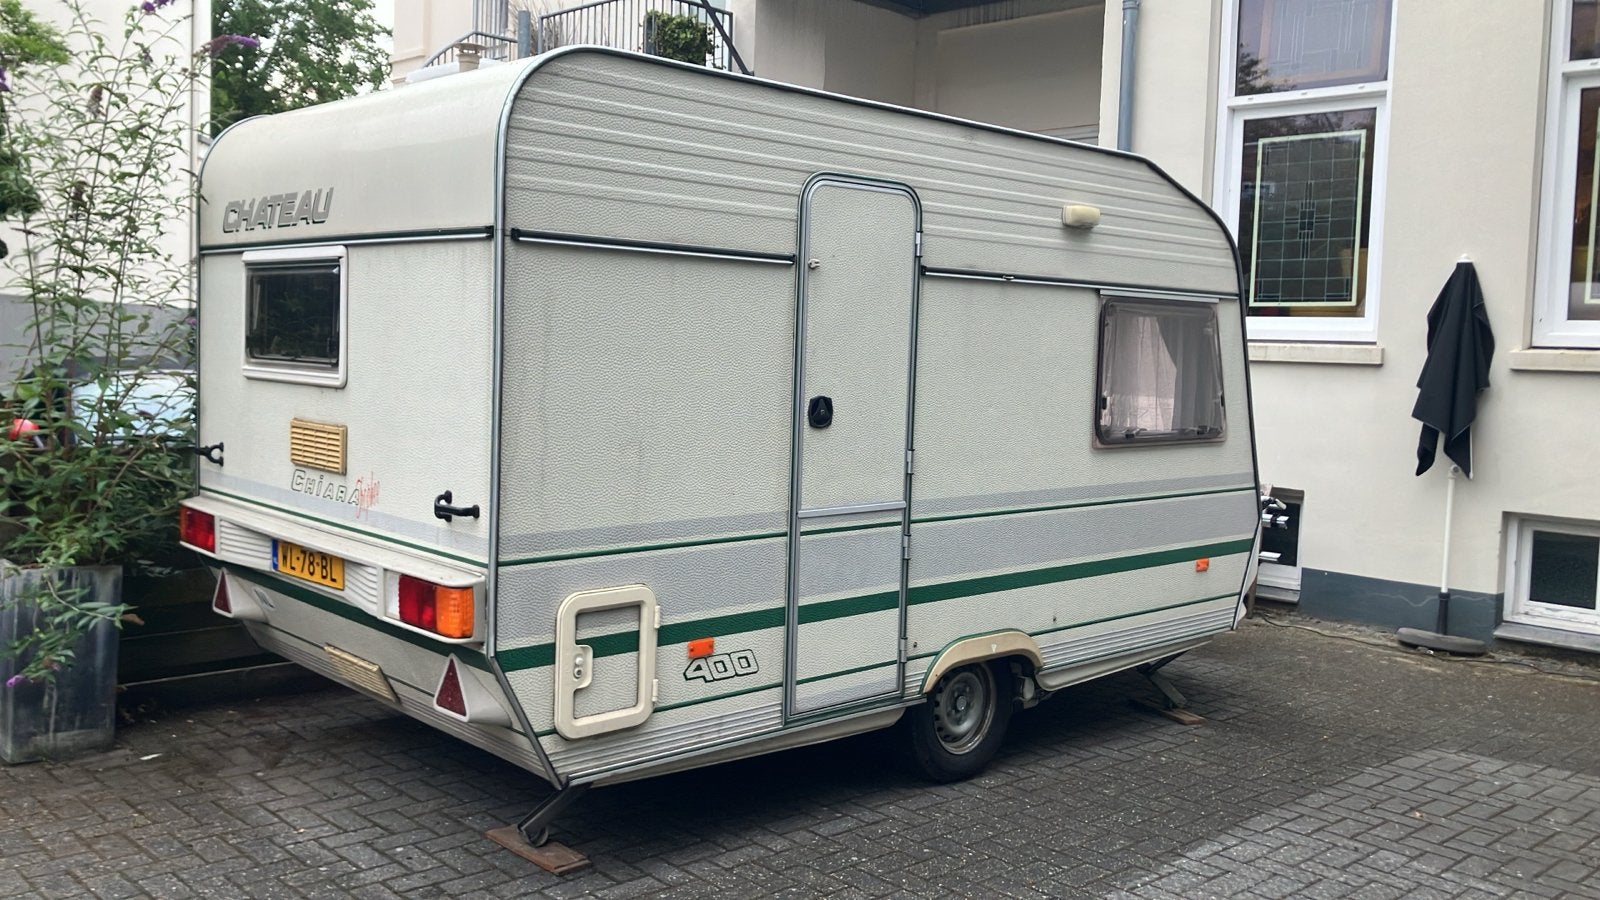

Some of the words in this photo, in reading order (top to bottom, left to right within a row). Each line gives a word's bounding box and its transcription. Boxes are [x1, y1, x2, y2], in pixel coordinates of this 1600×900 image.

[223, 187, 334, 233] CHATEAU
[281, 544, 337, 583] WL-78-BL
[683, 648, 760, 683] 400
